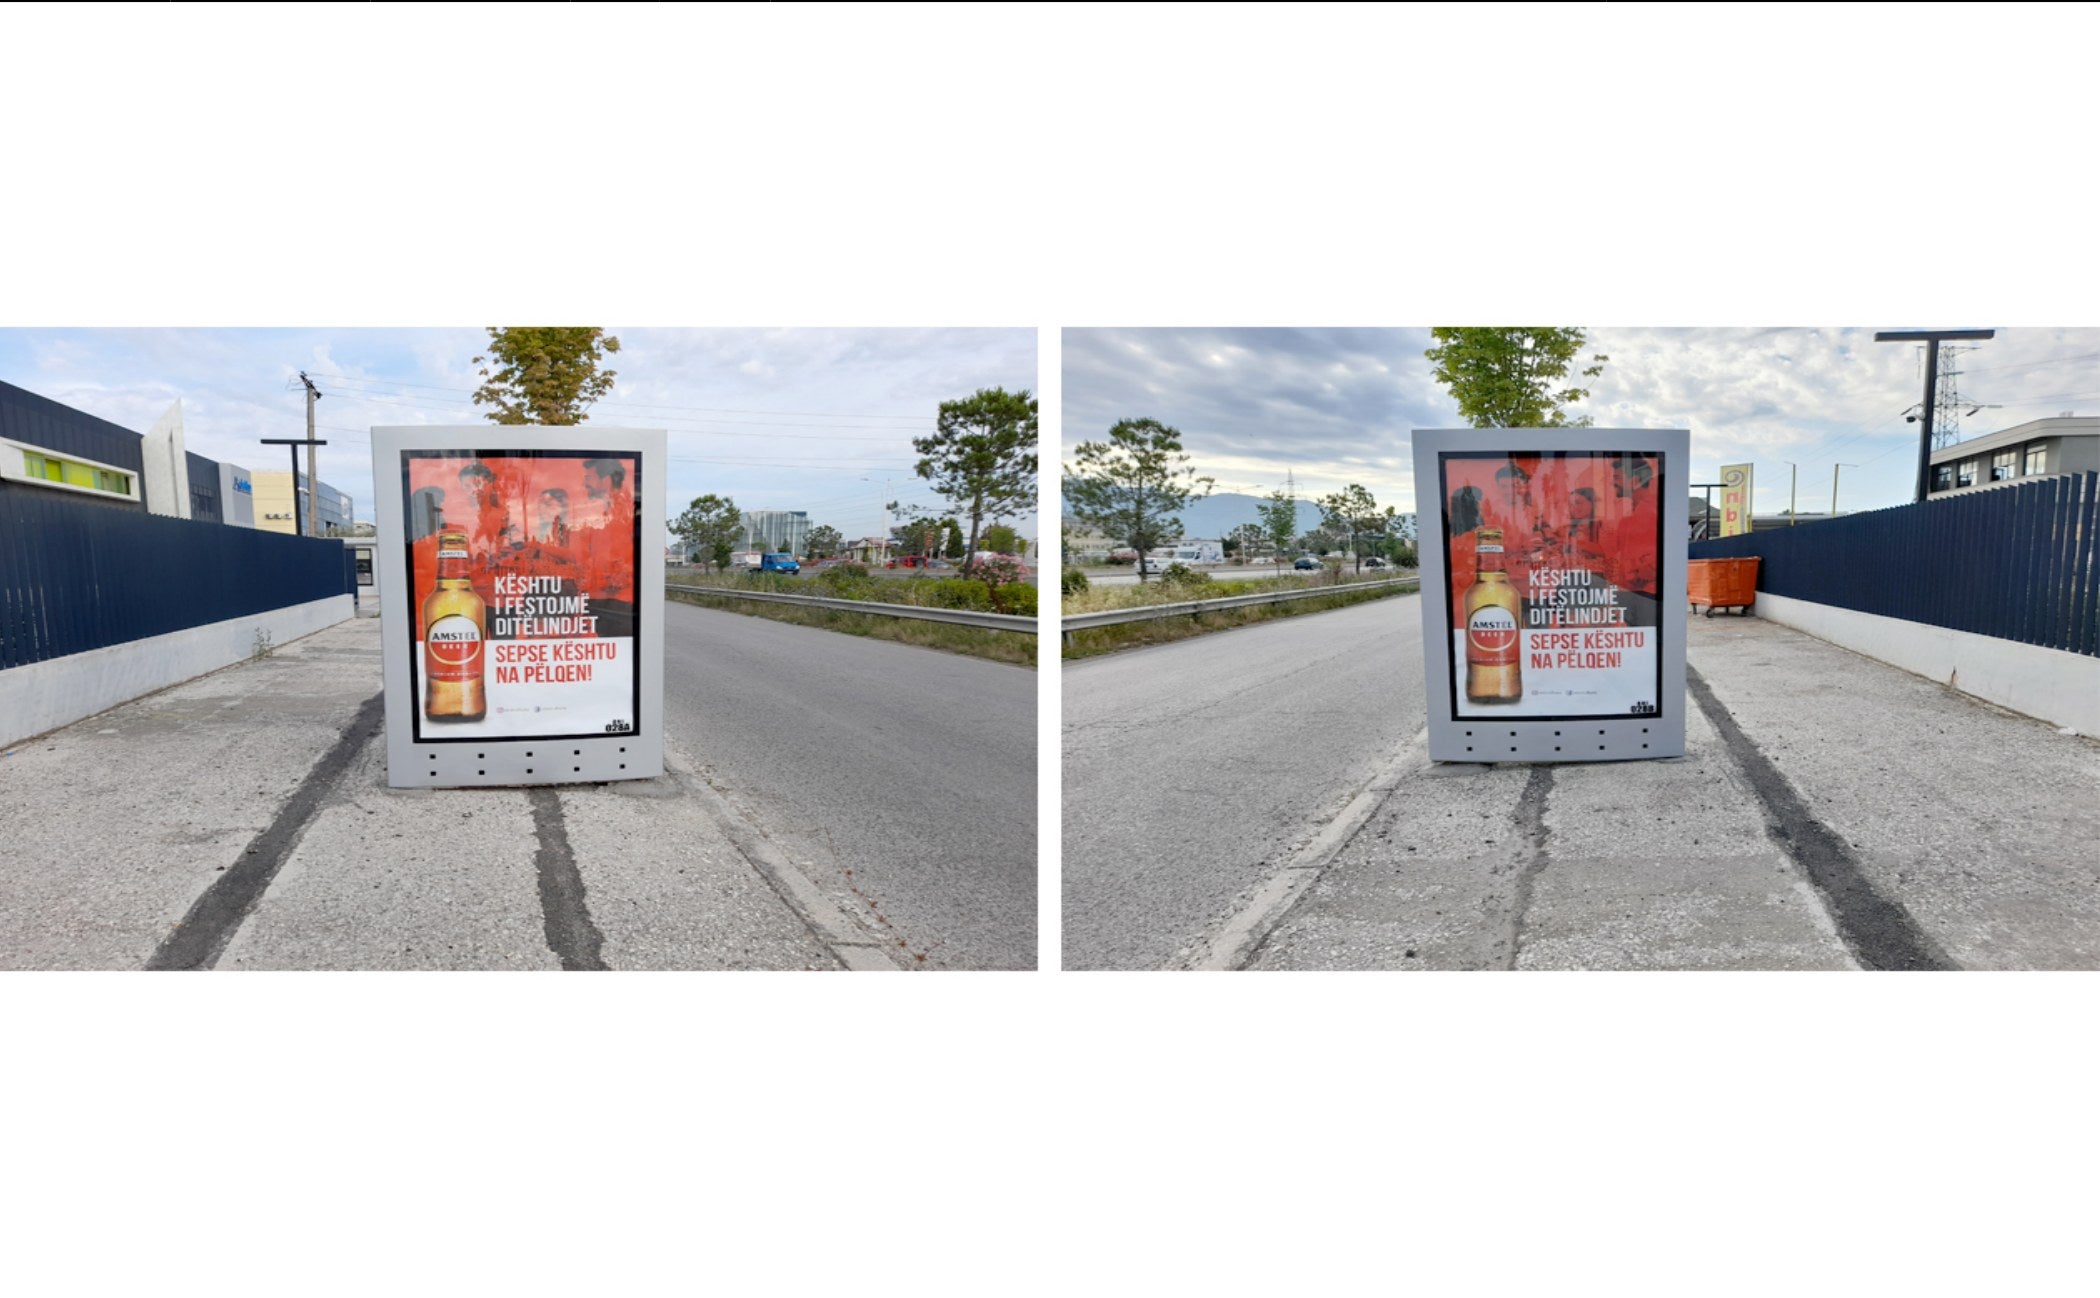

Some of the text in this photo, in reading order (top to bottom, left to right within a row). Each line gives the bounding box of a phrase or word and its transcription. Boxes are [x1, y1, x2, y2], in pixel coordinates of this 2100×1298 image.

[494, 573, 562, 594] KËSHTU
[1529, 567, 1591, 586] KËSHTU
[495, 593, 590, 615] I FESTOJMË
[1530, 586, 1619, 606] I FESTOJMË
[495, 615, 598, 636] DITËLINDJET
[1472, 621, 1513, 629] AMSTEL
[1530, 606, 1627, 625] DITËLINDJET
[432, 632, 476, 641] AMSTEL
[1530, 630, 1644, 650] SEPSE KËSHTU
[495, 641, 616, 663] SEPSE KËSHTU
[1531, 650, 1621, 669] NA PËLQEN!
[496, 663, 592, 684] NA PËLQEN!
